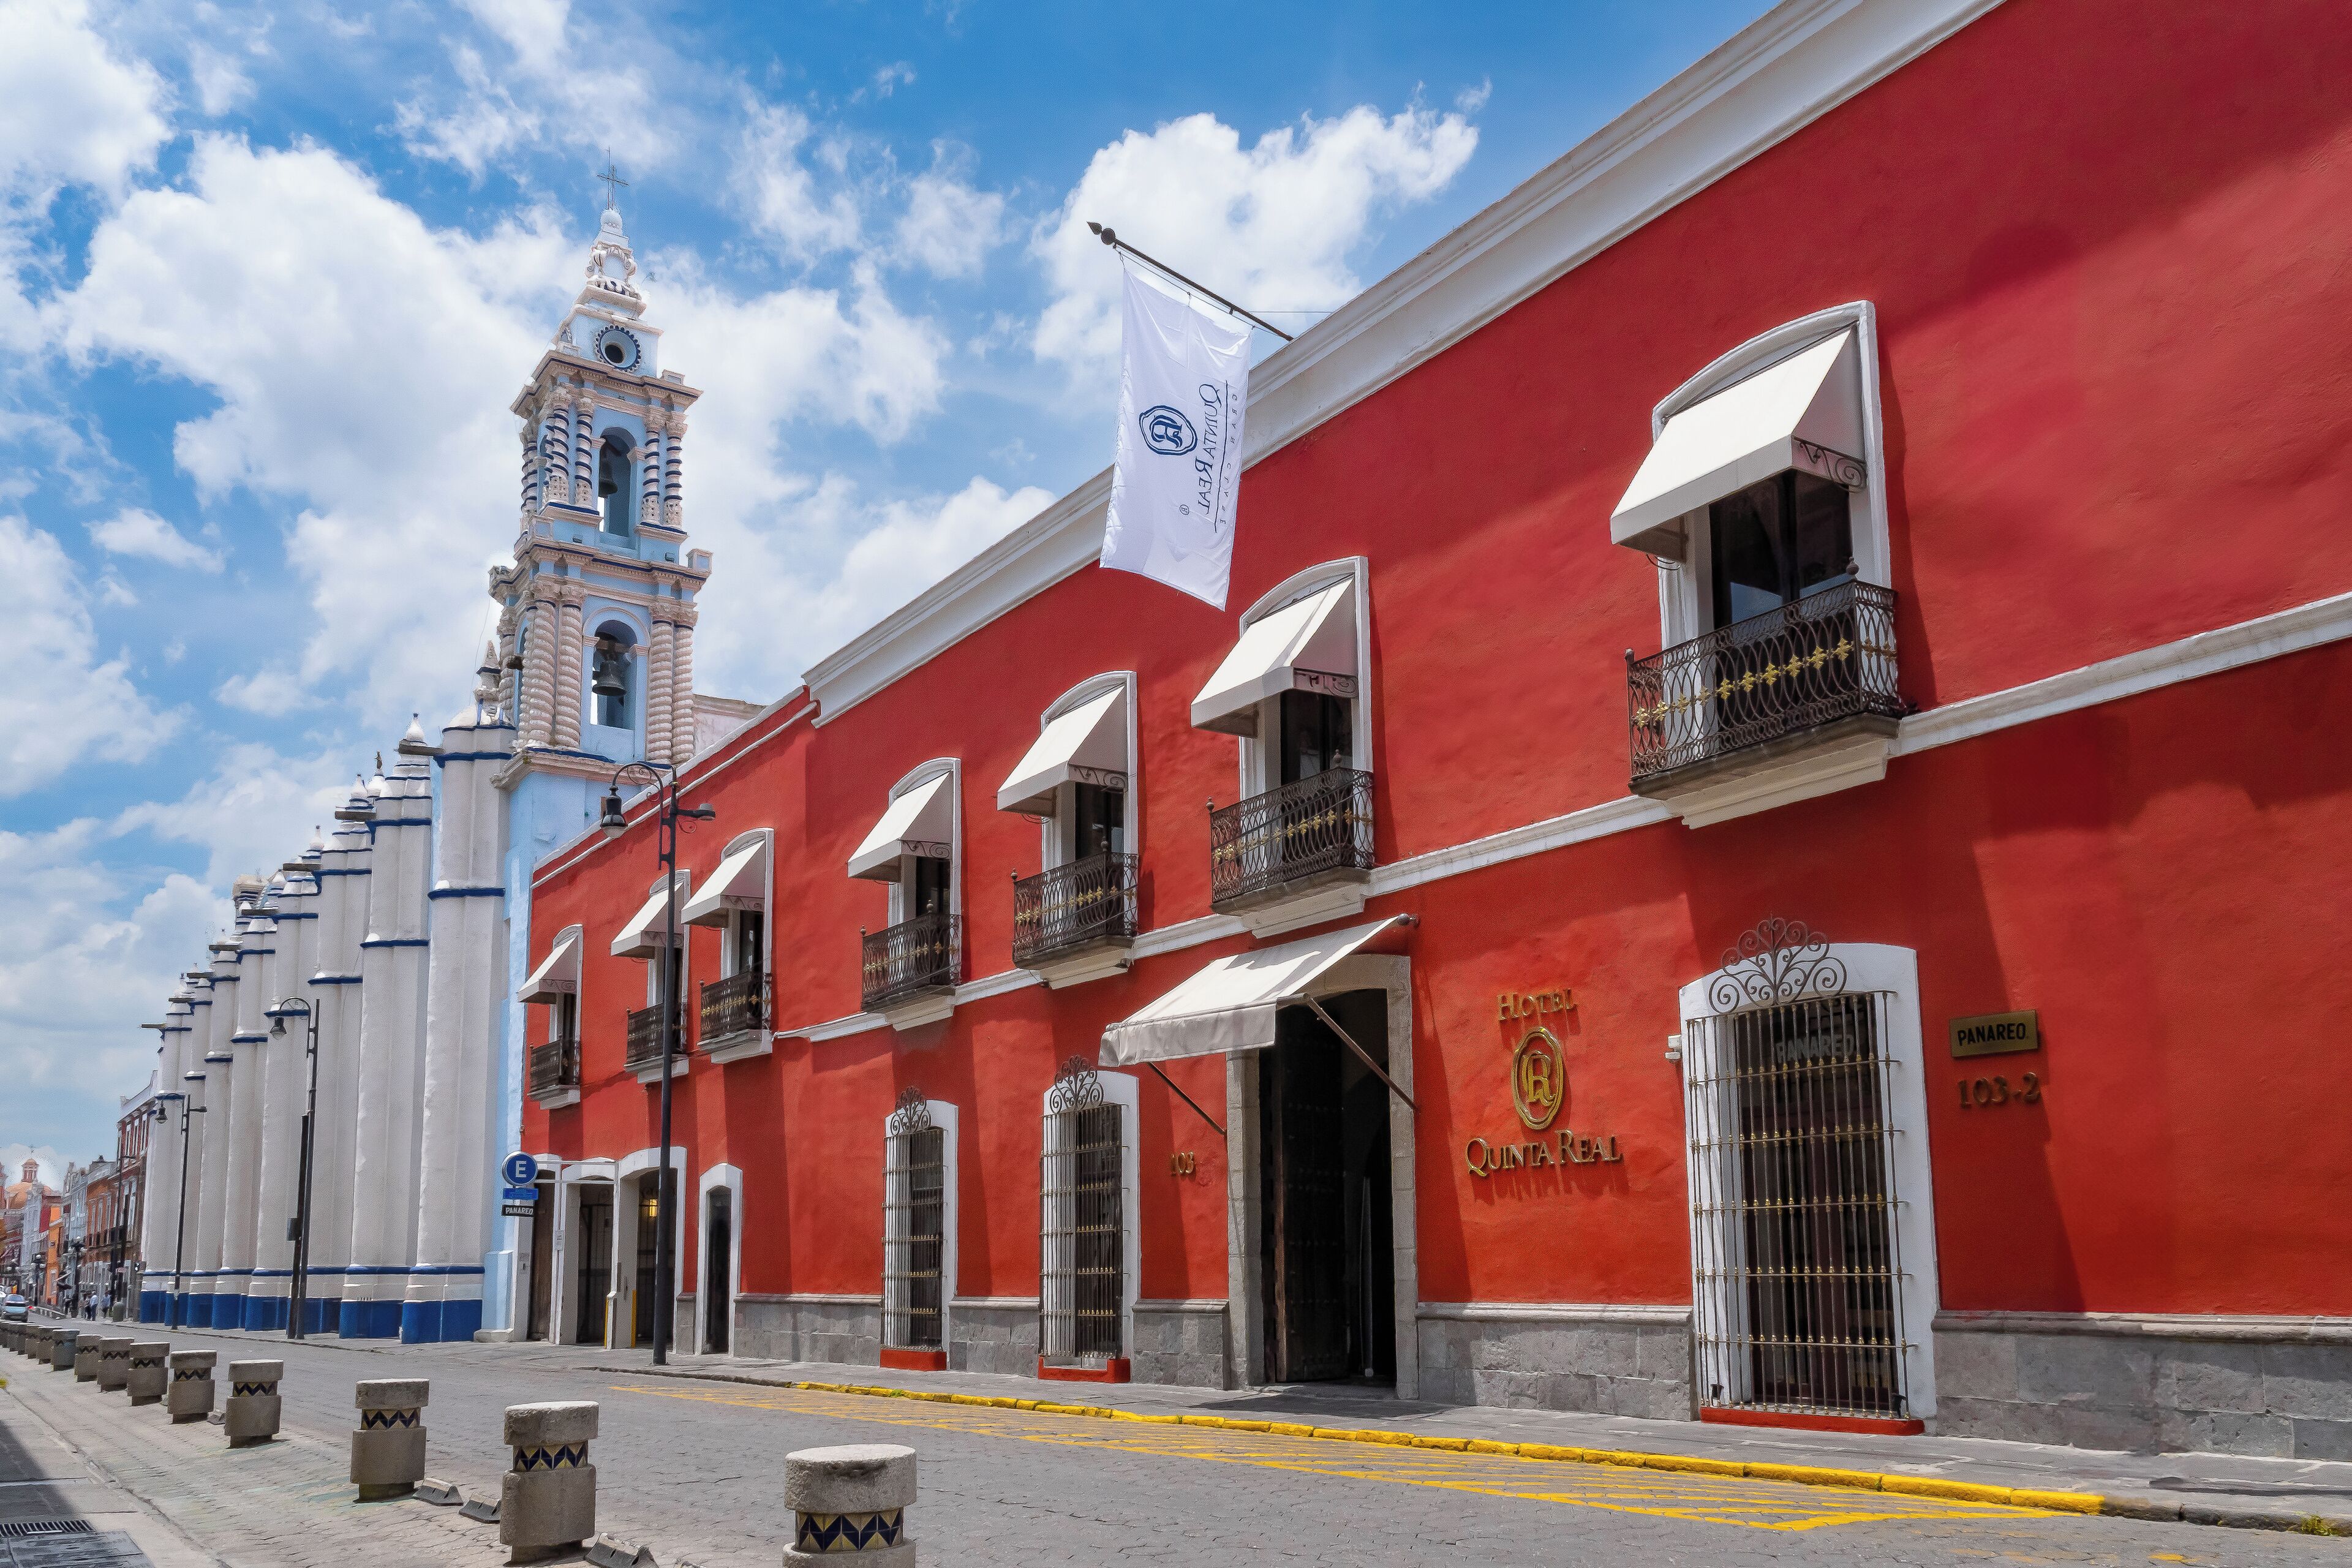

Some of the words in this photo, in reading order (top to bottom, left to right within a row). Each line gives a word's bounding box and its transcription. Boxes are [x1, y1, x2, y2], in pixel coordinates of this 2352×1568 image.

[1498, 989, 1578, 1020] HOTEL
[1957, 1023, 2027, 1046] PANAREO
[1958, 1072, 2041, 1109] 103-2
[1170, 1152, 1194, 1176] 103
[1466, 1137, 1555, 1176] QUINTA
[1555, 1129, 1624, 1163] REAL
[515, 1160, 527, 1177] E
